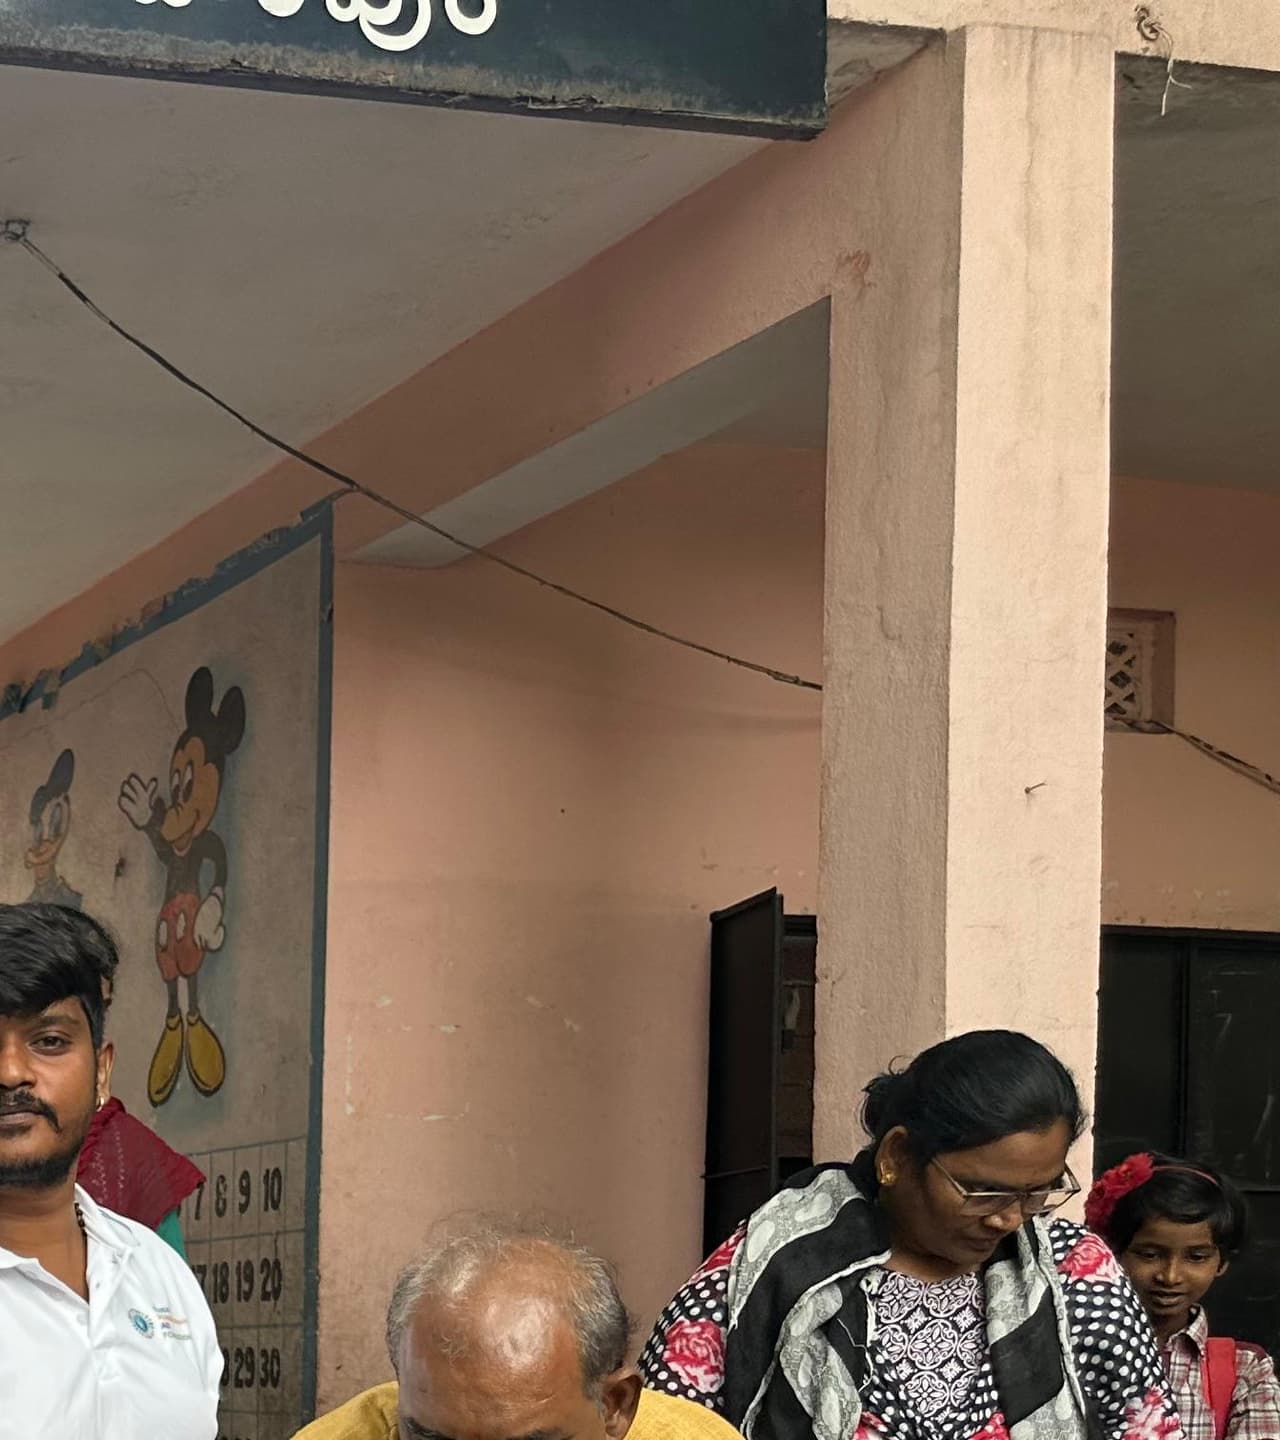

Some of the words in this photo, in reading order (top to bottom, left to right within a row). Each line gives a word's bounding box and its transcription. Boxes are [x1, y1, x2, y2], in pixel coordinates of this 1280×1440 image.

[238, 1170, 251, 1214] 9
[263, 1167, 283, 1212] 10
[213, 1261, 230, 1304] 18
[236, 1260, 255, 1302] 19
[260, 1257, 282, 1301] 20
[234, 1346, 256, 1389] 29
[259, 1347, 281, 1389] 30
